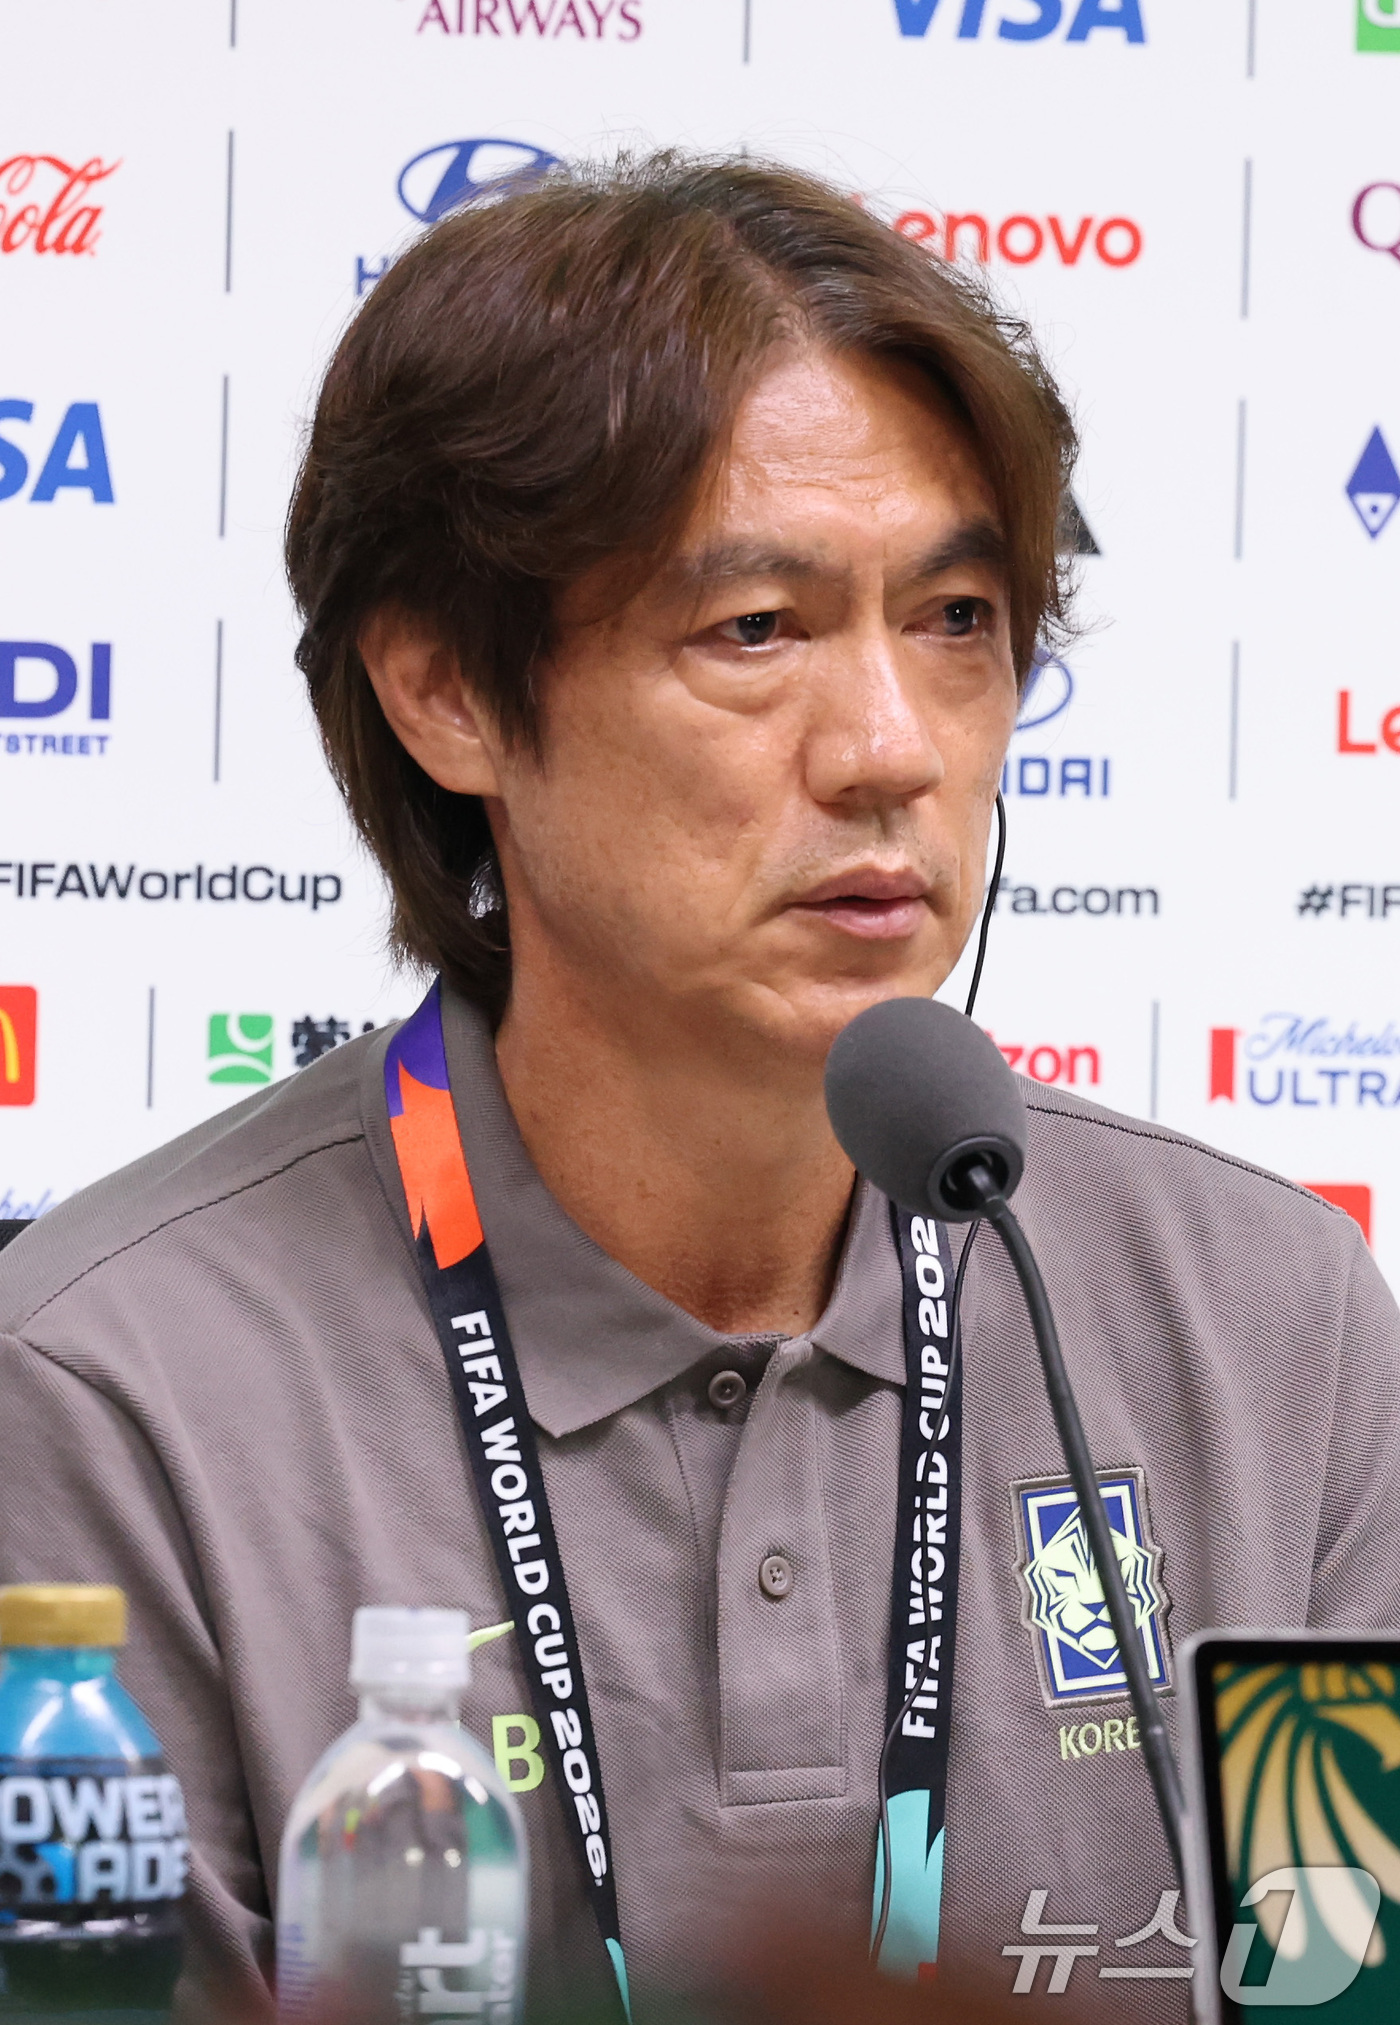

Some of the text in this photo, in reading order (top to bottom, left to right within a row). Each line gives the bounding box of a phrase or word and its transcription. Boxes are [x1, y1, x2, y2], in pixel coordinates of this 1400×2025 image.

[416, 0, 641, 41] AIRWAYS
[892, 210, 1143, 267] enovo
[0, 733, 110, 755] STREET
[1248, 1068, 1400, 1107] ULTR
[910, 1215, 949, 1338] 202
[918, 1344, 951, 1441] CUP
[450, 1309, 508, 1417] FIFA
[480, 1416, 550, 1596] WORLD
[526, 1603, 574, 1701] CUP
[901, 1634, 943, 1740] FIFA
[1059, 1716, 1142, 1761] KORE
